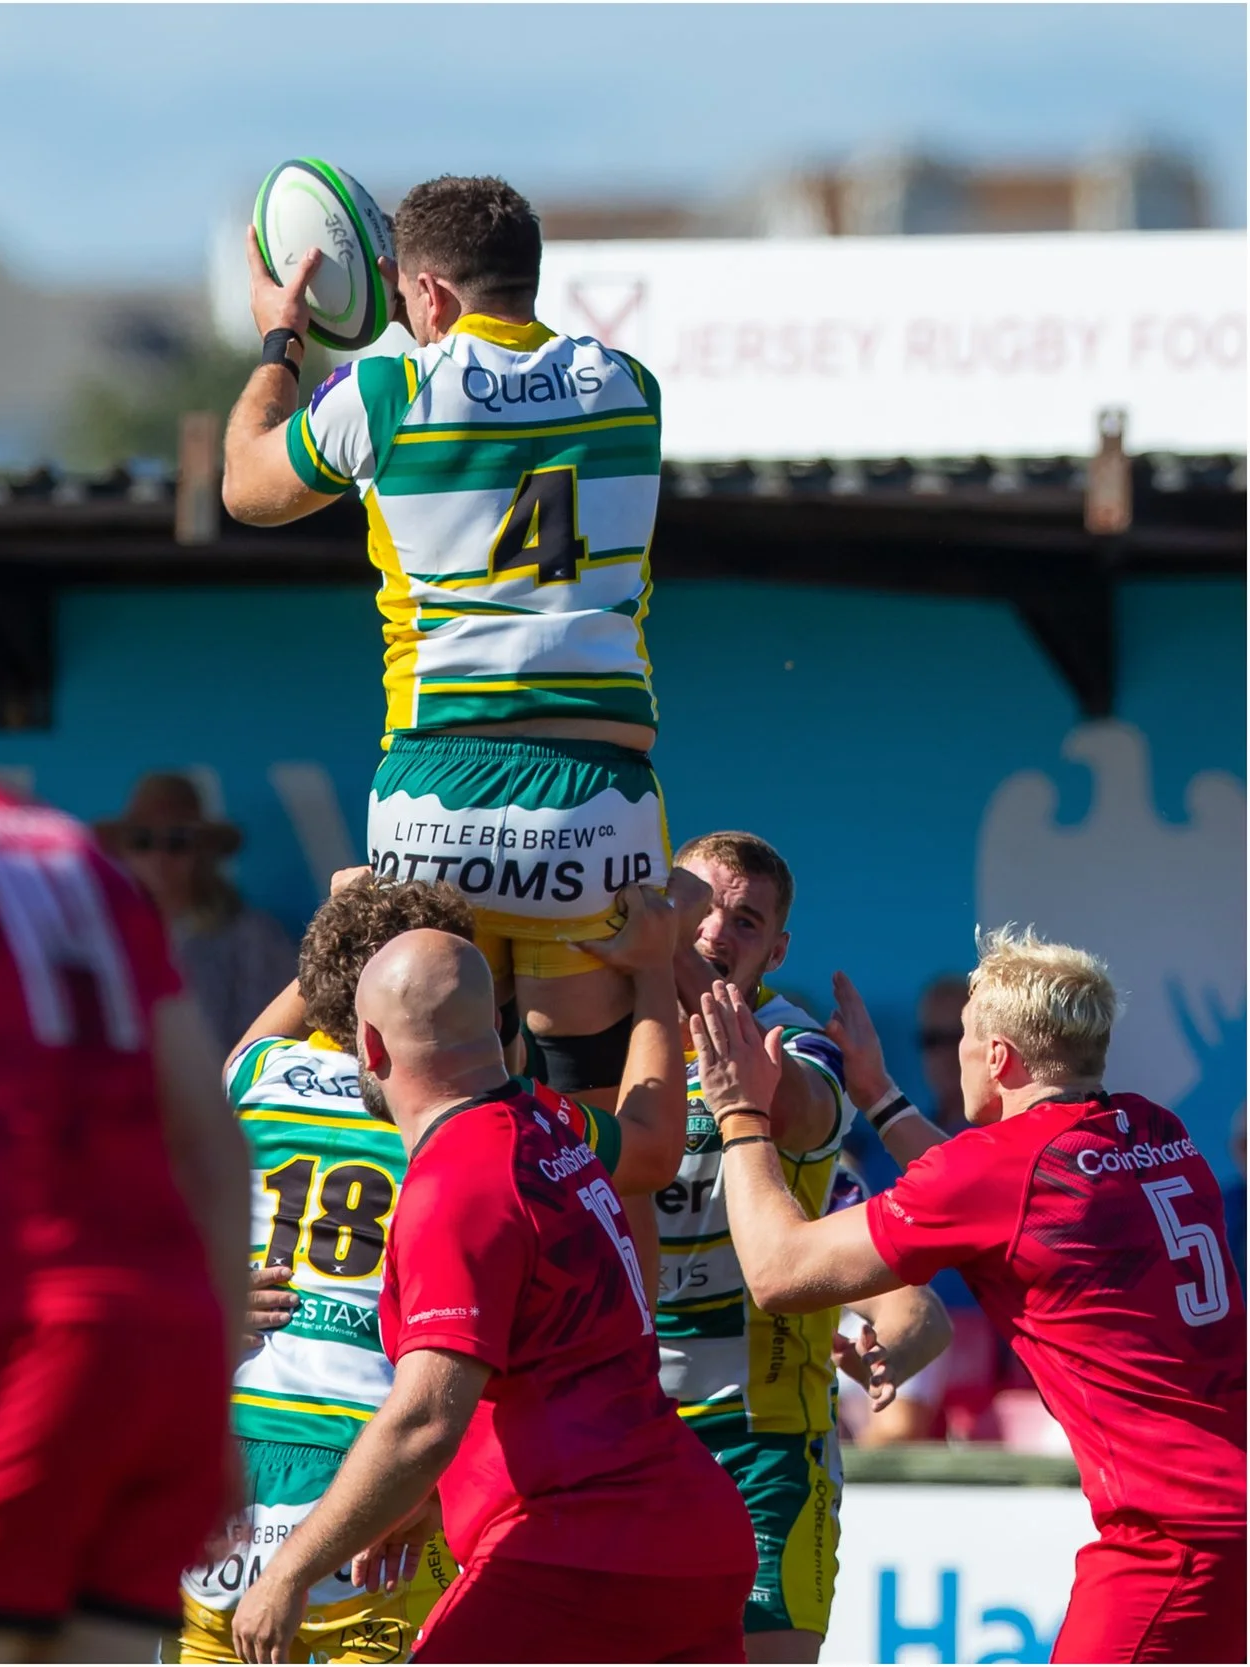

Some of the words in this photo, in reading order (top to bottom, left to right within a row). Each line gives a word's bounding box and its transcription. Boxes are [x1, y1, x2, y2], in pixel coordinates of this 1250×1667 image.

[661, 318, 884, 380] JERSEY
[902, 313, 1108, 378] RUGBY
[462, 363, 603, 413] Qualis
[488, 464, 589, 588] 4
[283, 1065, 362, 1098] Qua
[687, 1118, 714, 1131] DERS
[1077, 1136, 1198, 1175] CoinShares
[263, 1154, 397, 1281] 18
[576, 1178, 654, 1336] 16
[1141, 1175, 1230, 1327] 5
[880, 1570, 1051, 1664] Ha
